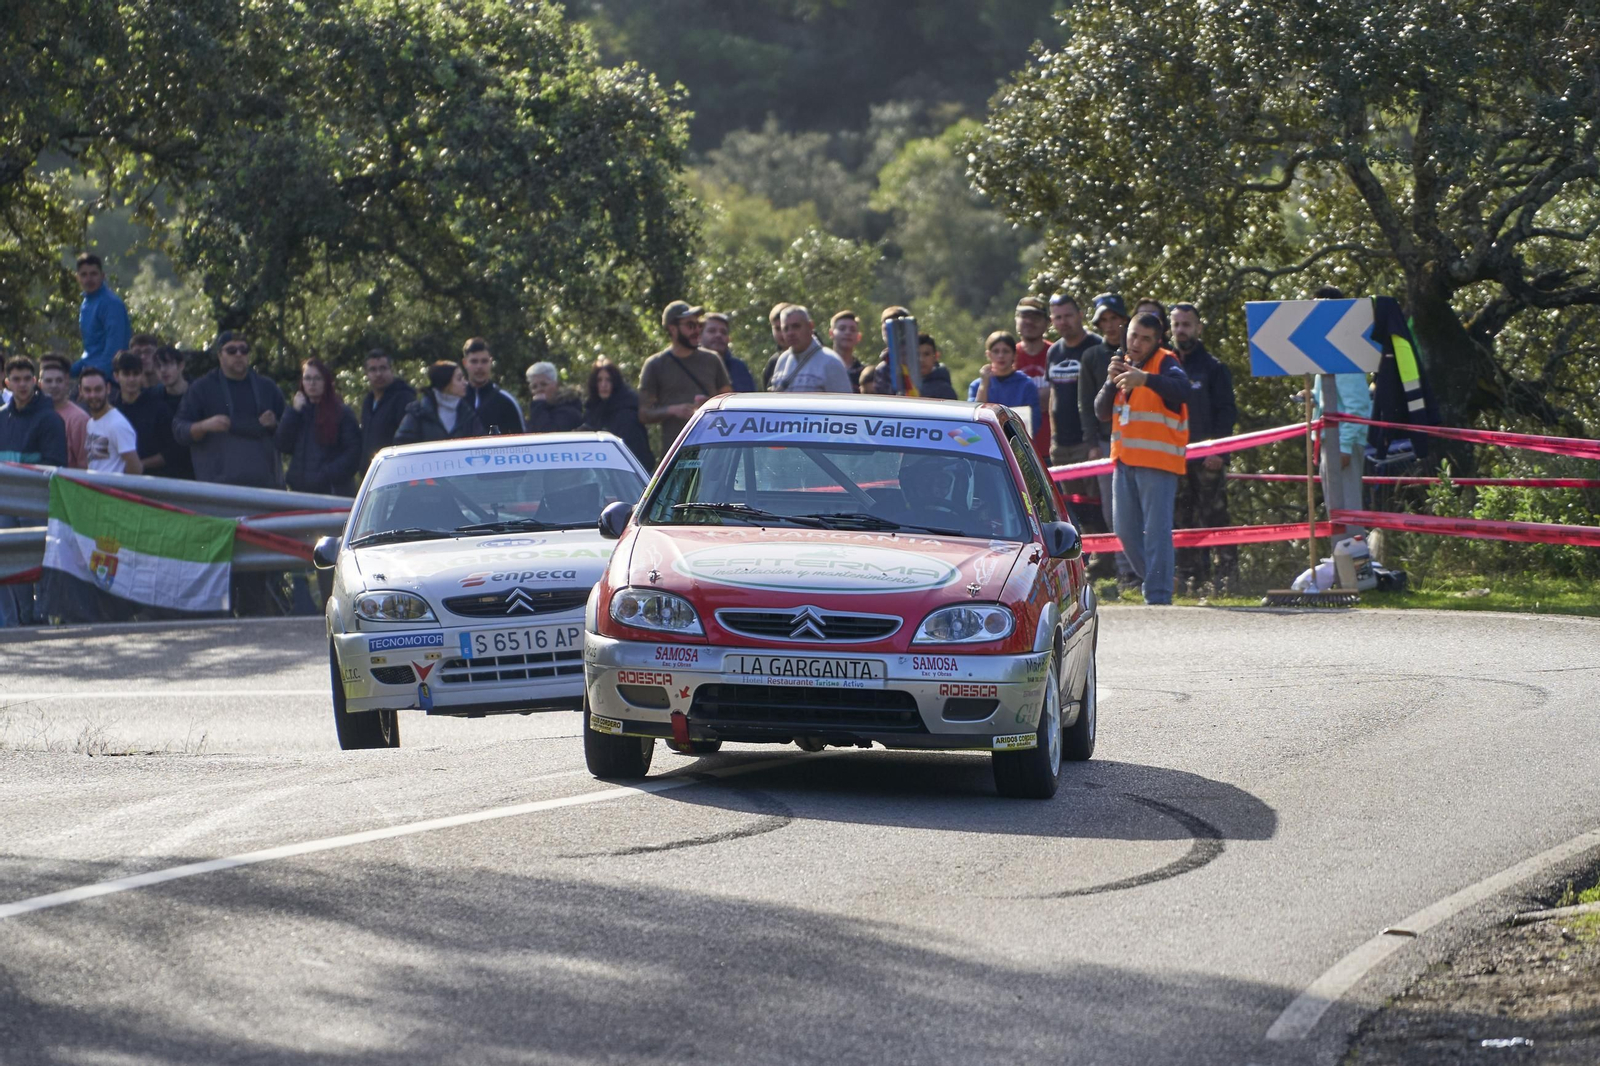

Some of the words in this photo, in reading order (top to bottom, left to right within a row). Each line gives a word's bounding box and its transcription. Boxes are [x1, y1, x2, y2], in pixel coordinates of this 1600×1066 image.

[739, 416, 858, 435] Aluminios
[864, 419, 943, 442] Valero
[396, 458, 464, 477] DENTAL
[494, 452, 608, 466] BAQUERIZO
[757, 530, 943, 547] GARGANTA
[491, 569, 576, 583] enpeca
[691, 557, 941, 580] EFITERMA
[812, 569, 919, 585] mantenimiento
[370, 634, 443, 650] TECNOMOTOR
[475, 634, 488, 653] S
[494, 630, 548, 652] 6516
[555, 627, 580, 648] AP
[655, 646, 698, 662] SAMOSA
[741, 656, 763, 675] LA
[769, 658, 872, 680] GARGANTA
[913, 656, 958, 671] SAMOSA
[617, 670, 673, 686] ROESCA
[742, 676, 763, 685] Hotel
[767, 677, 814, 687] Restaurante
[815, 679, 840, 688] Turismo
[843, 680, 864, 689] Activo
[940, 683, 998, 697] ROESCA
[996, 735, 1018, 744] ARIDOS
